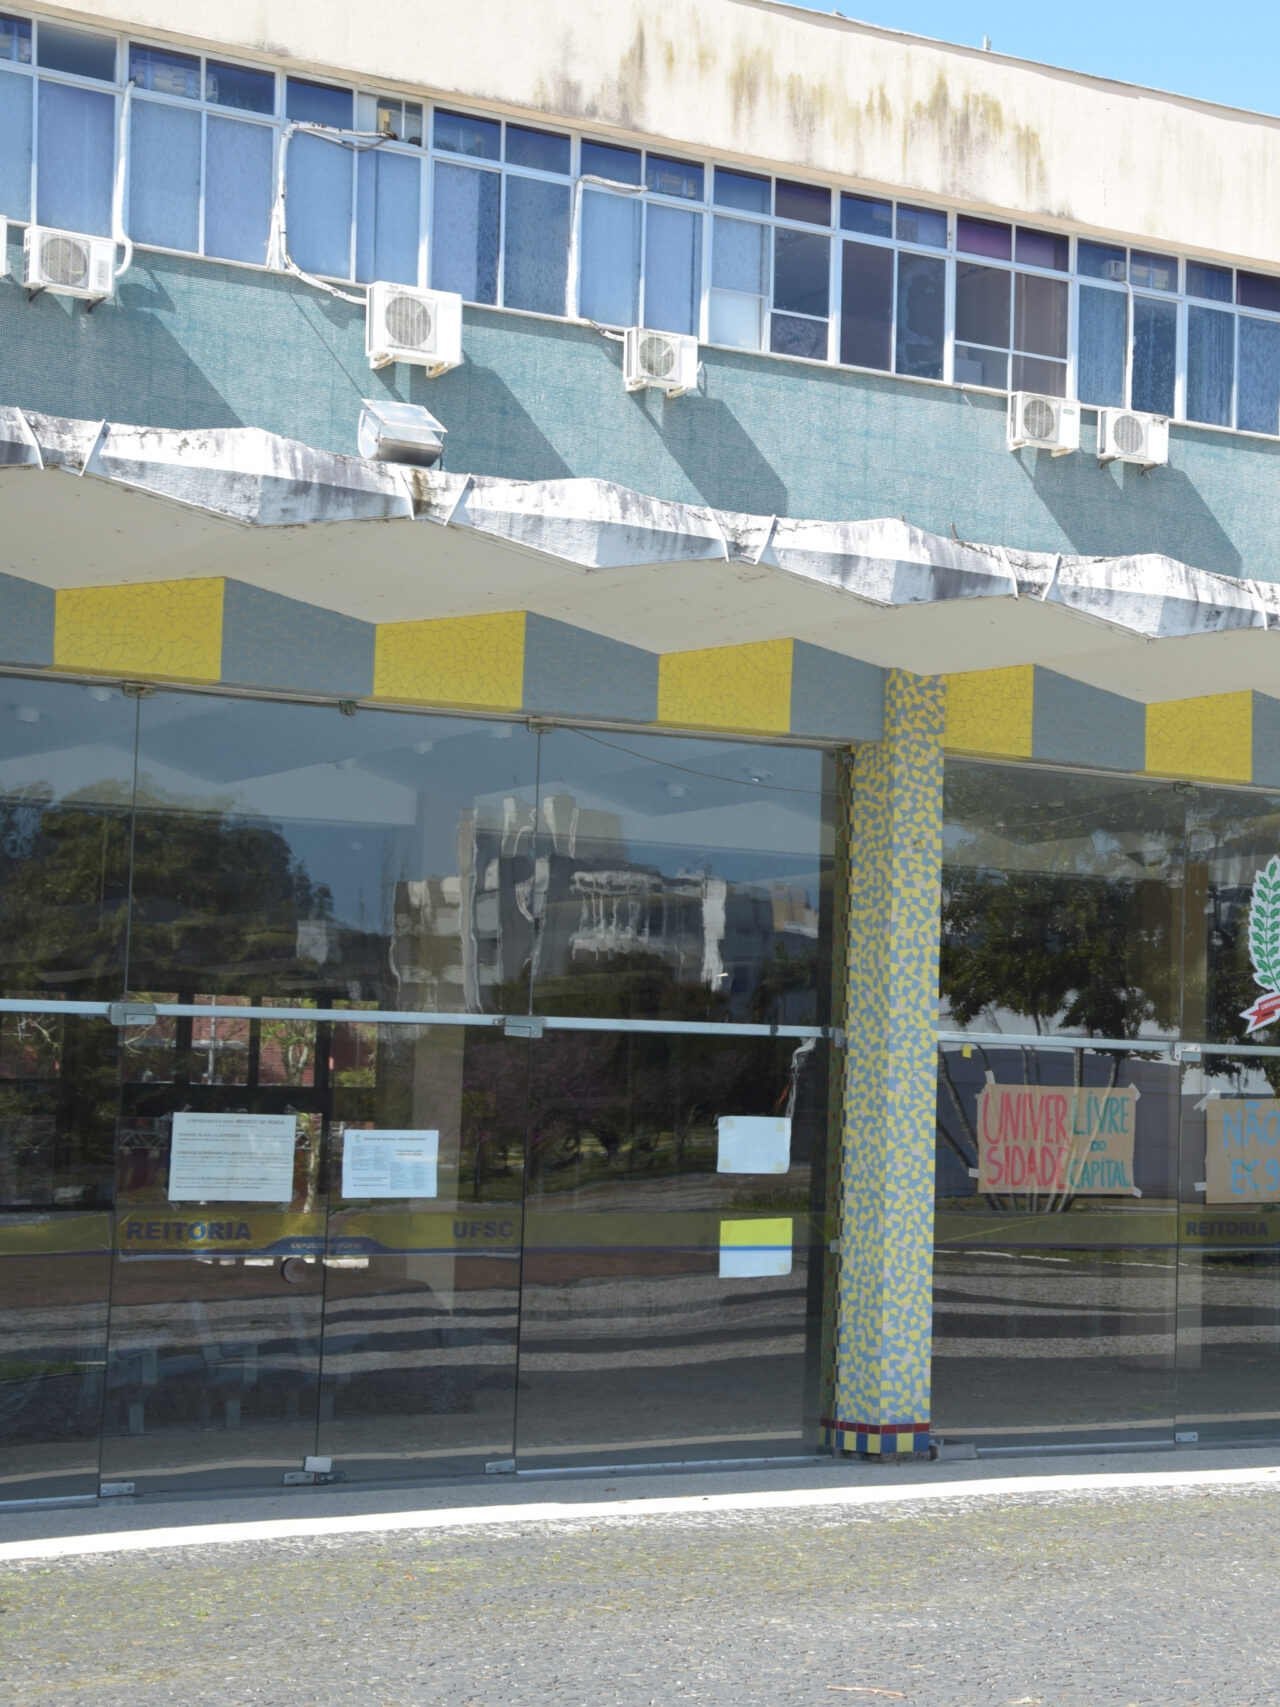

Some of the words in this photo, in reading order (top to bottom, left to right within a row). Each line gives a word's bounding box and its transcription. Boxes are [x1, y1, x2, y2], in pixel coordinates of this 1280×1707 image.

[986, 1146, 1067, 1189] SIDADE
[1069, 1156, 1131, 1189] CAPITAL
[127, 1222, 251, 1241] REITORIA
[453, 1221, 514, 1239] UFSC
[1186, 1221, 1269, 1236] REITORIA
